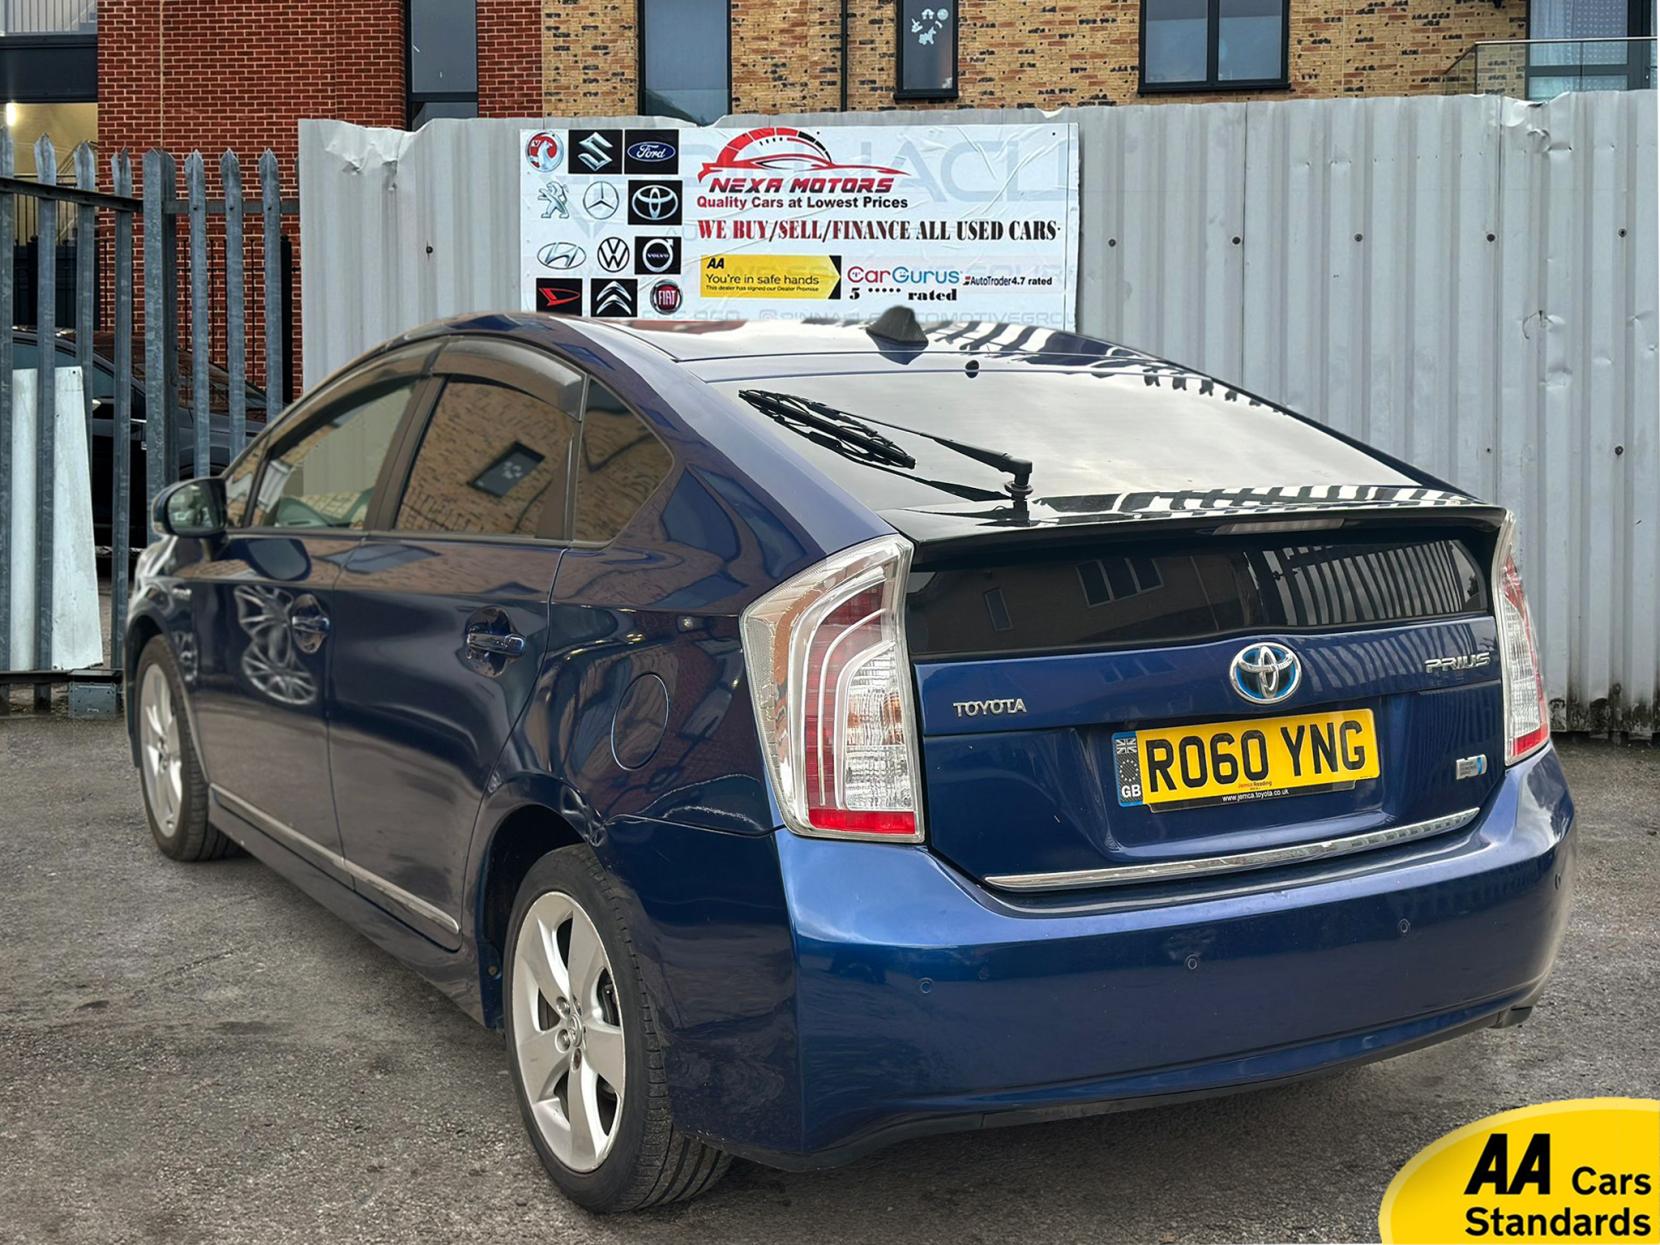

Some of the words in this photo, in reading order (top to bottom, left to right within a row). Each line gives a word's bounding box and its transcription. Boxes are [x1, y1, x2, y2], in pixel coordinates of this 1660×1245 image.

[636, 144, 666, 159] Ford
[709, 178, 784, 193] NEXA
[789, 178, 894, 193] MOTORS
[697, 196, 747, 210] Quality
[752, 196, 783, 208] Cars
[788, 197, 802, 208] at
[807, 196, 858, 208] Lowest
[863, 196, 908, 208] Prices
[697, 220, 727, 239] WE
[733, 220, 911, 242] BUY/SELL/FINANCE
[916, 220, 951, 240] ALL
[956, 220, 1003, 240] USED
[1009, 220, 1057, 240] CARS
[647, 251, 669, 259] VOLVO
[706, 257, 724, 269] AA
[706, 274, 741, 284] You're
[744, 274, 754, 284] in
[757, 274, 781, 285] safe
[784, 275, 820, 285] hands
[847, 266, 960, 284] CarGurus
[1028, 277, 1053, 285] rated
[658, 290, 677, 305] FIAT
[849, 287, 860, 300] 5
[908, 288, 957, 301] rated
[1424, 652, 1490, 673] PRIUS
[952, 698, 1027, 717] TOYOTA
[1146, 730, 1268, 792] RO60
[1281, 720, 1365, 776] YNG
[1121, 784, 1141, 797] GB
